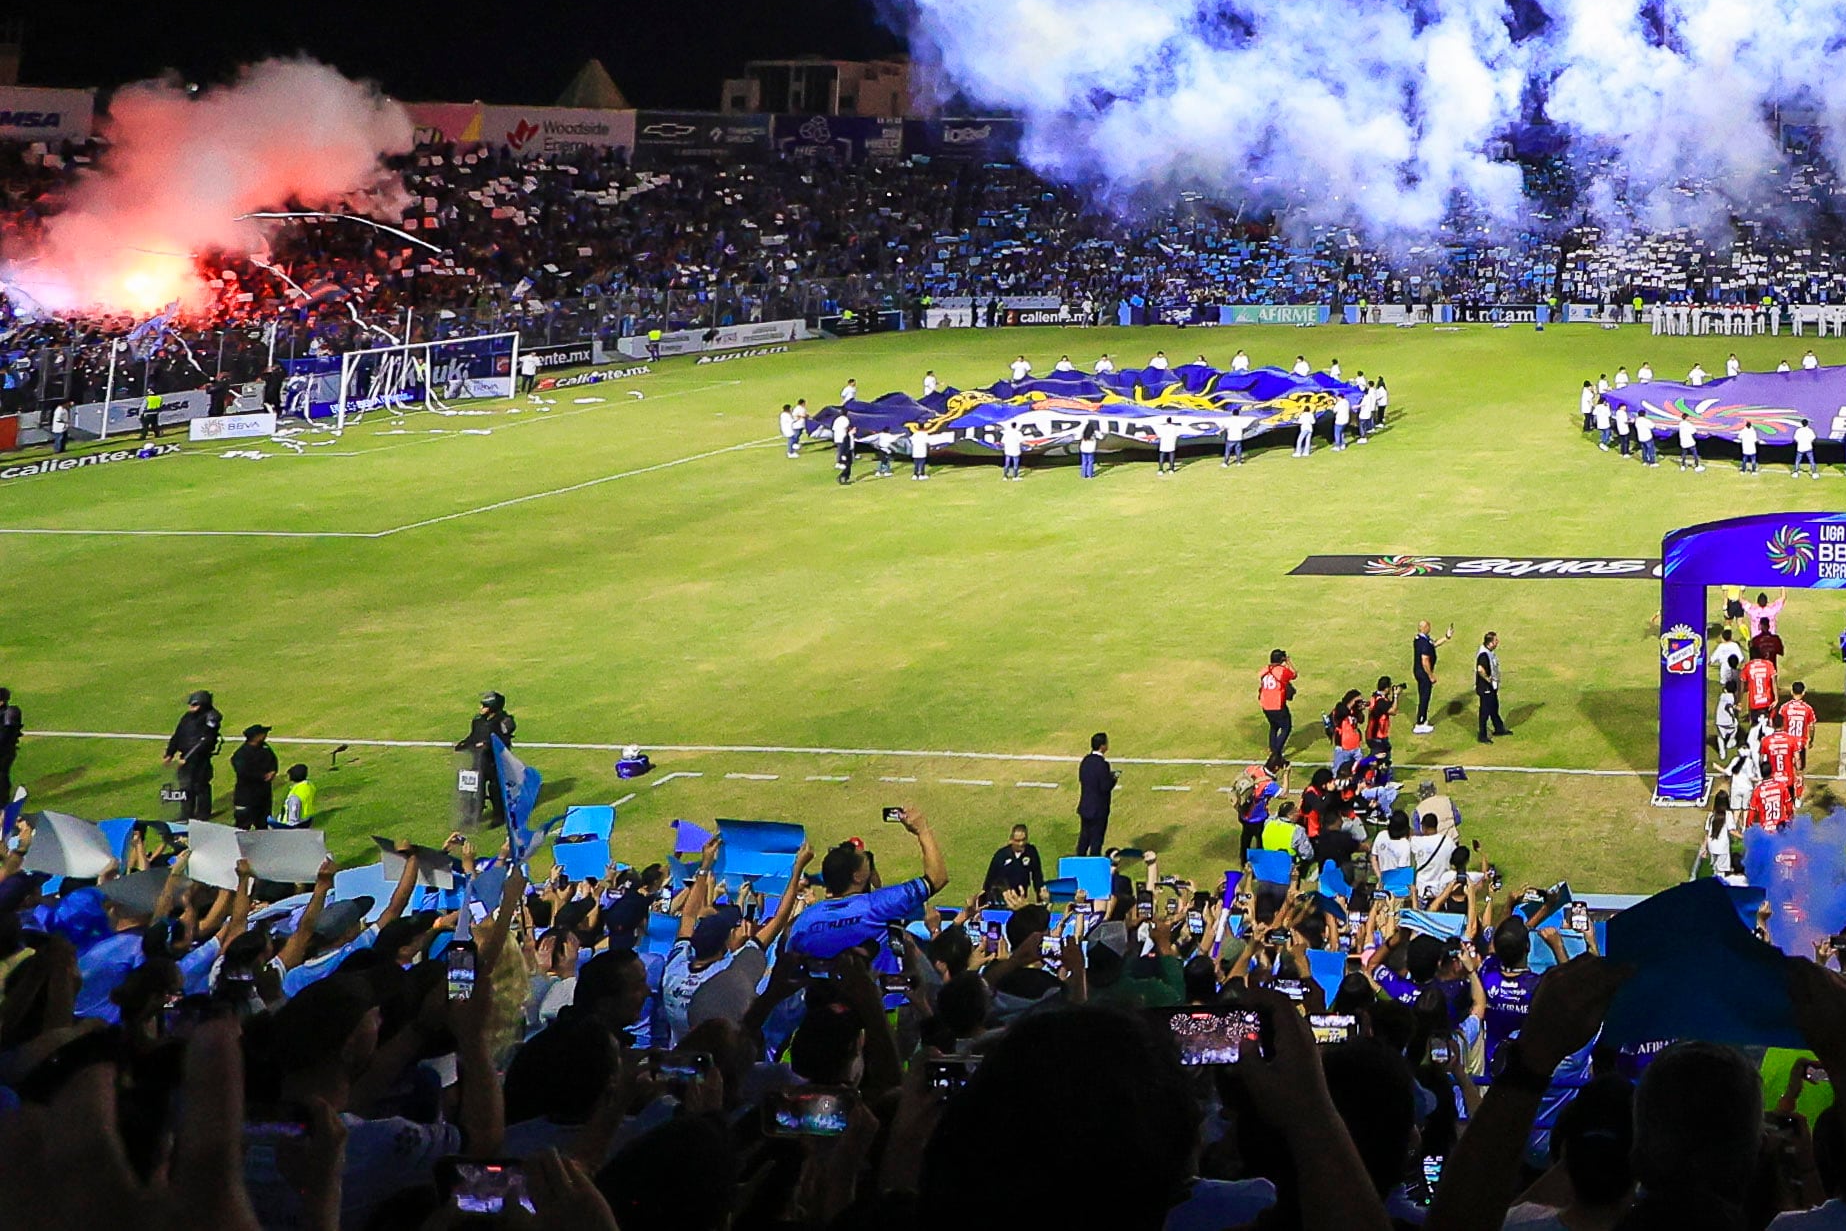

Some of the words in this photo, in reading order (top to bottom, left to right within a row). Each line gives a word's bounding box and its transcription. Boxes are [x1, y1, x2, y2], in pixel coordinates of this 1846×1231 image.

[544, 121, 609, 135] Woodside
[1259, 308, 1317, 322] AFIRME
[1820, 525, 1845, 541] LIGA
[1451, 559, 1645, 576] SOMOS
[1262, 675, 1277, 689] 16
[1776, 754, 1784, 771] 6
[1764, 800, 1780, 820] 25
